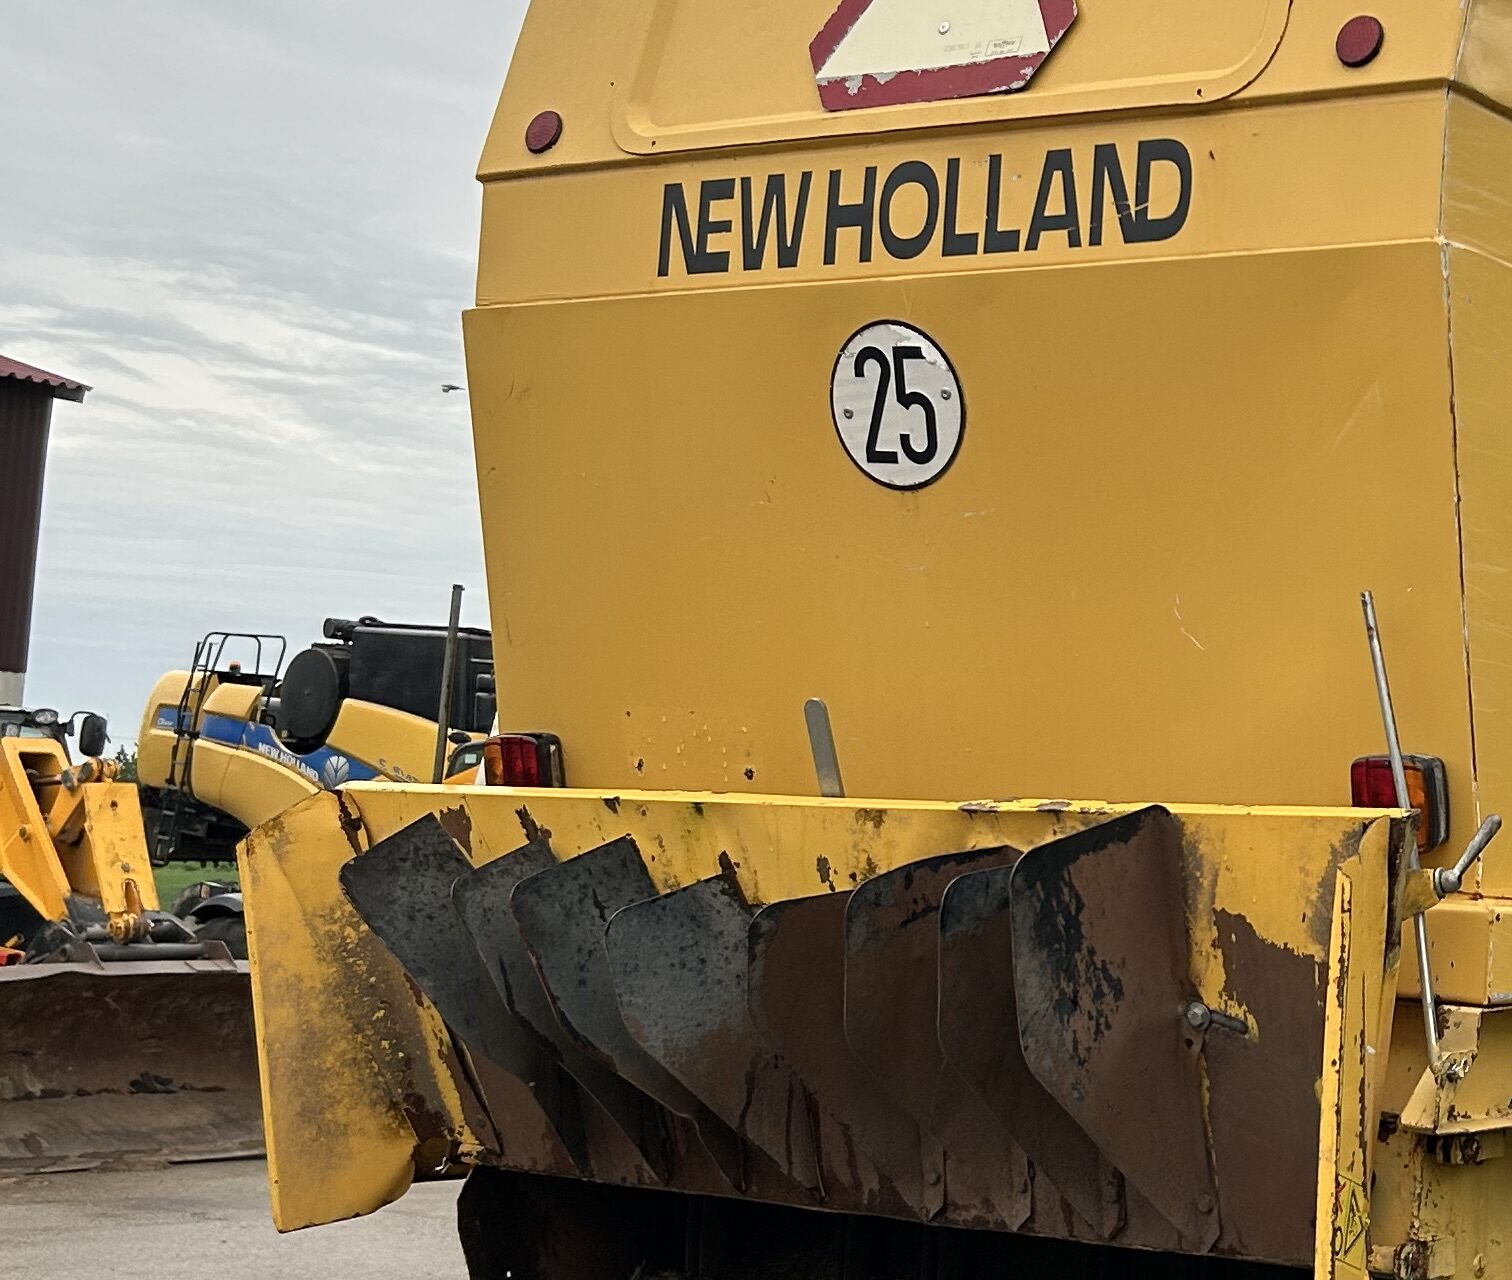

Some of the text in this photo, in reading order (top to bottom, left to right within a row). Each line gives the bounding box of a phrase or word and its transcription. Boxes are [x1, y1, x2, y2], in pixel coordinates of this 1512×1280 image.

[657, 137, 1193, 278] NEW HOLLAND
[853, 345, 939, 465] 25
[258, 741, 319, 782] NEW HOLLAND
